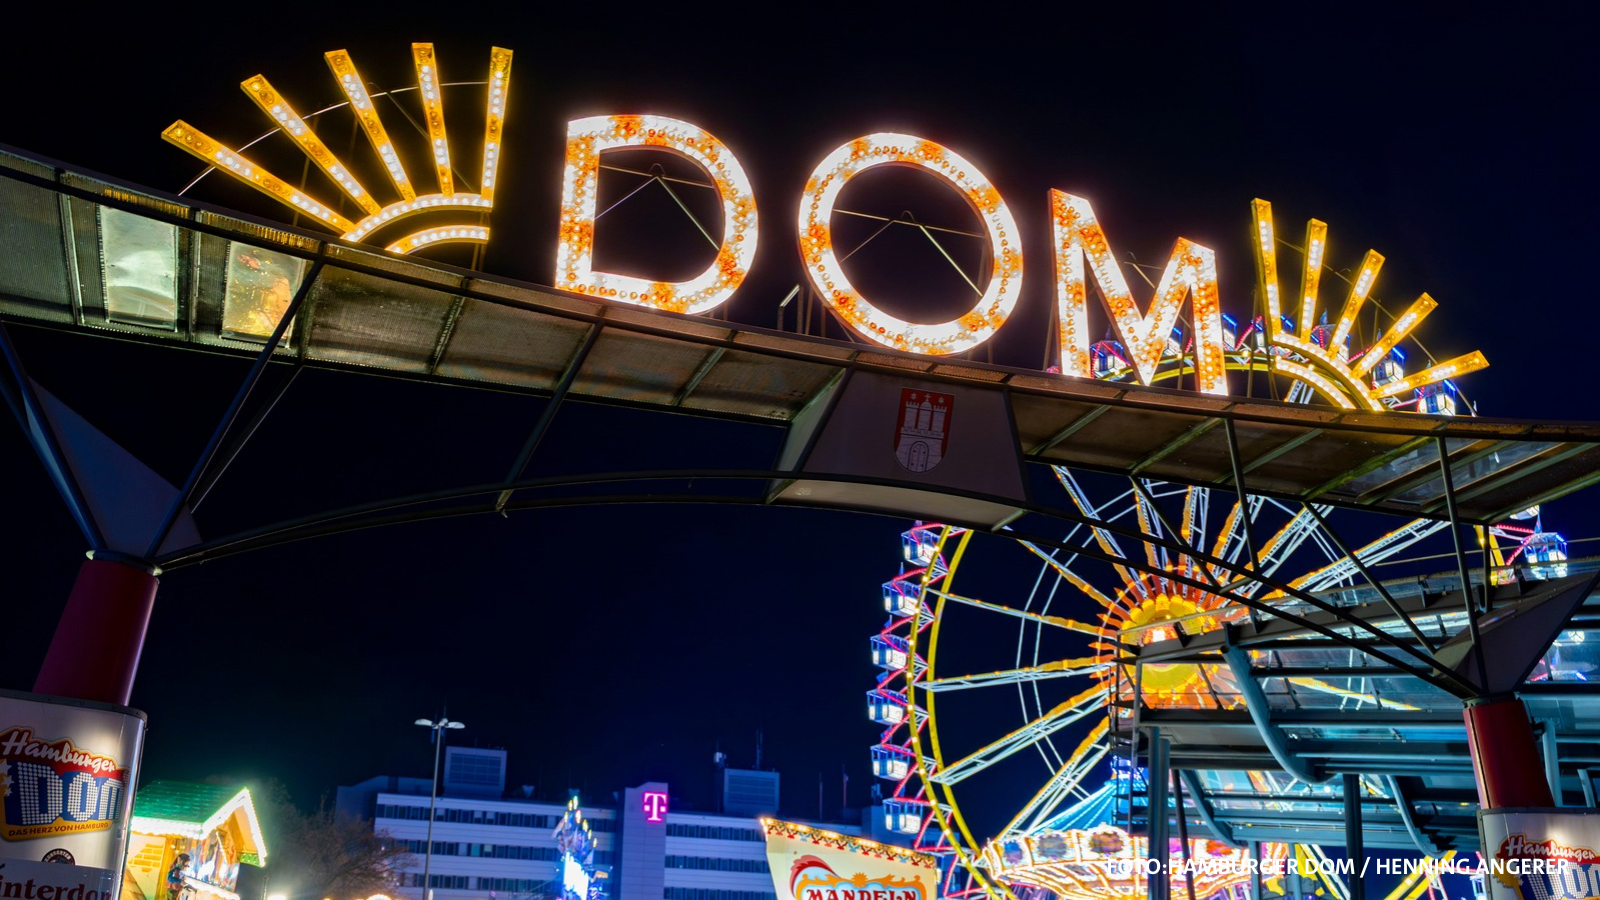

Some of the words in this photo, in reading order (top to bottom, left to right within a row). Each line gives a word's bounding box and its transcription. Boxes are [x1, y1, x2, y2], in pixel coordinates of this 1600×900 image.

[554, 114, 1229, 396] DOM
[2, 731, 115, 773] Hamburger
[18, 761, 124, 825] DOM
[9, 829, 28, 837] DAS
[29, 826, 53, 835] HERZ
[54, 824, 74, 832] VON
[74, 822, 109, 831] HAMBURG
[1505, 836, 1596, 862] Hamburger
